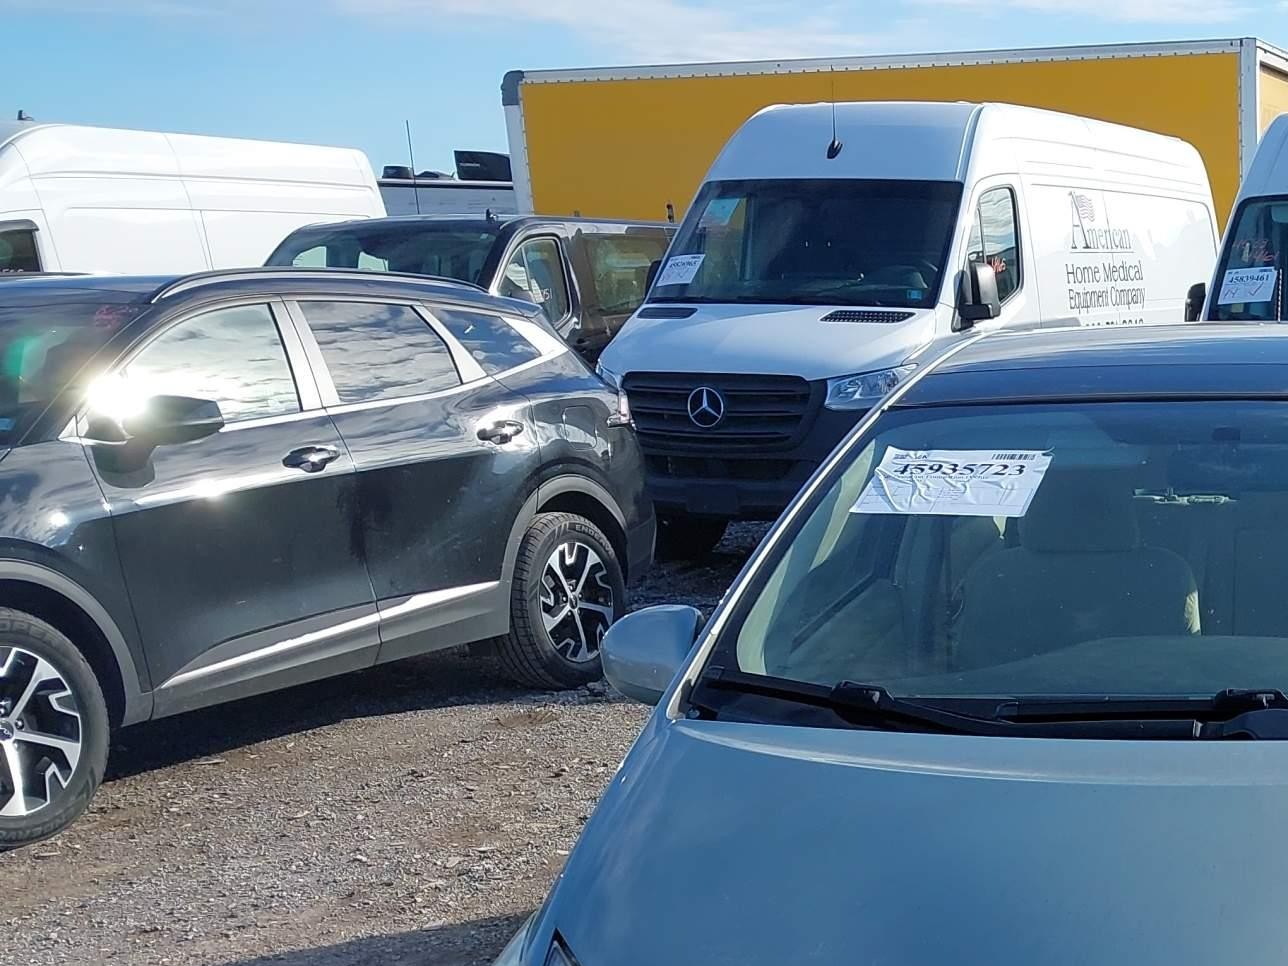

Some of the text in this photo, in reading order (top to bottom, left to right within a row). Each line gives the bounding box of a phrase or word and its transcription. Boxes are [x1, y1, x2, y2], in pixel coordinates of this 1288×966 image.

[1069, 190, 1131, 249] American
[1065, 260, 1144, 284] Home Medical
[1068, 285, 1146, 314] Equipment Company
[893, 463, 1026, 476] 45935723
